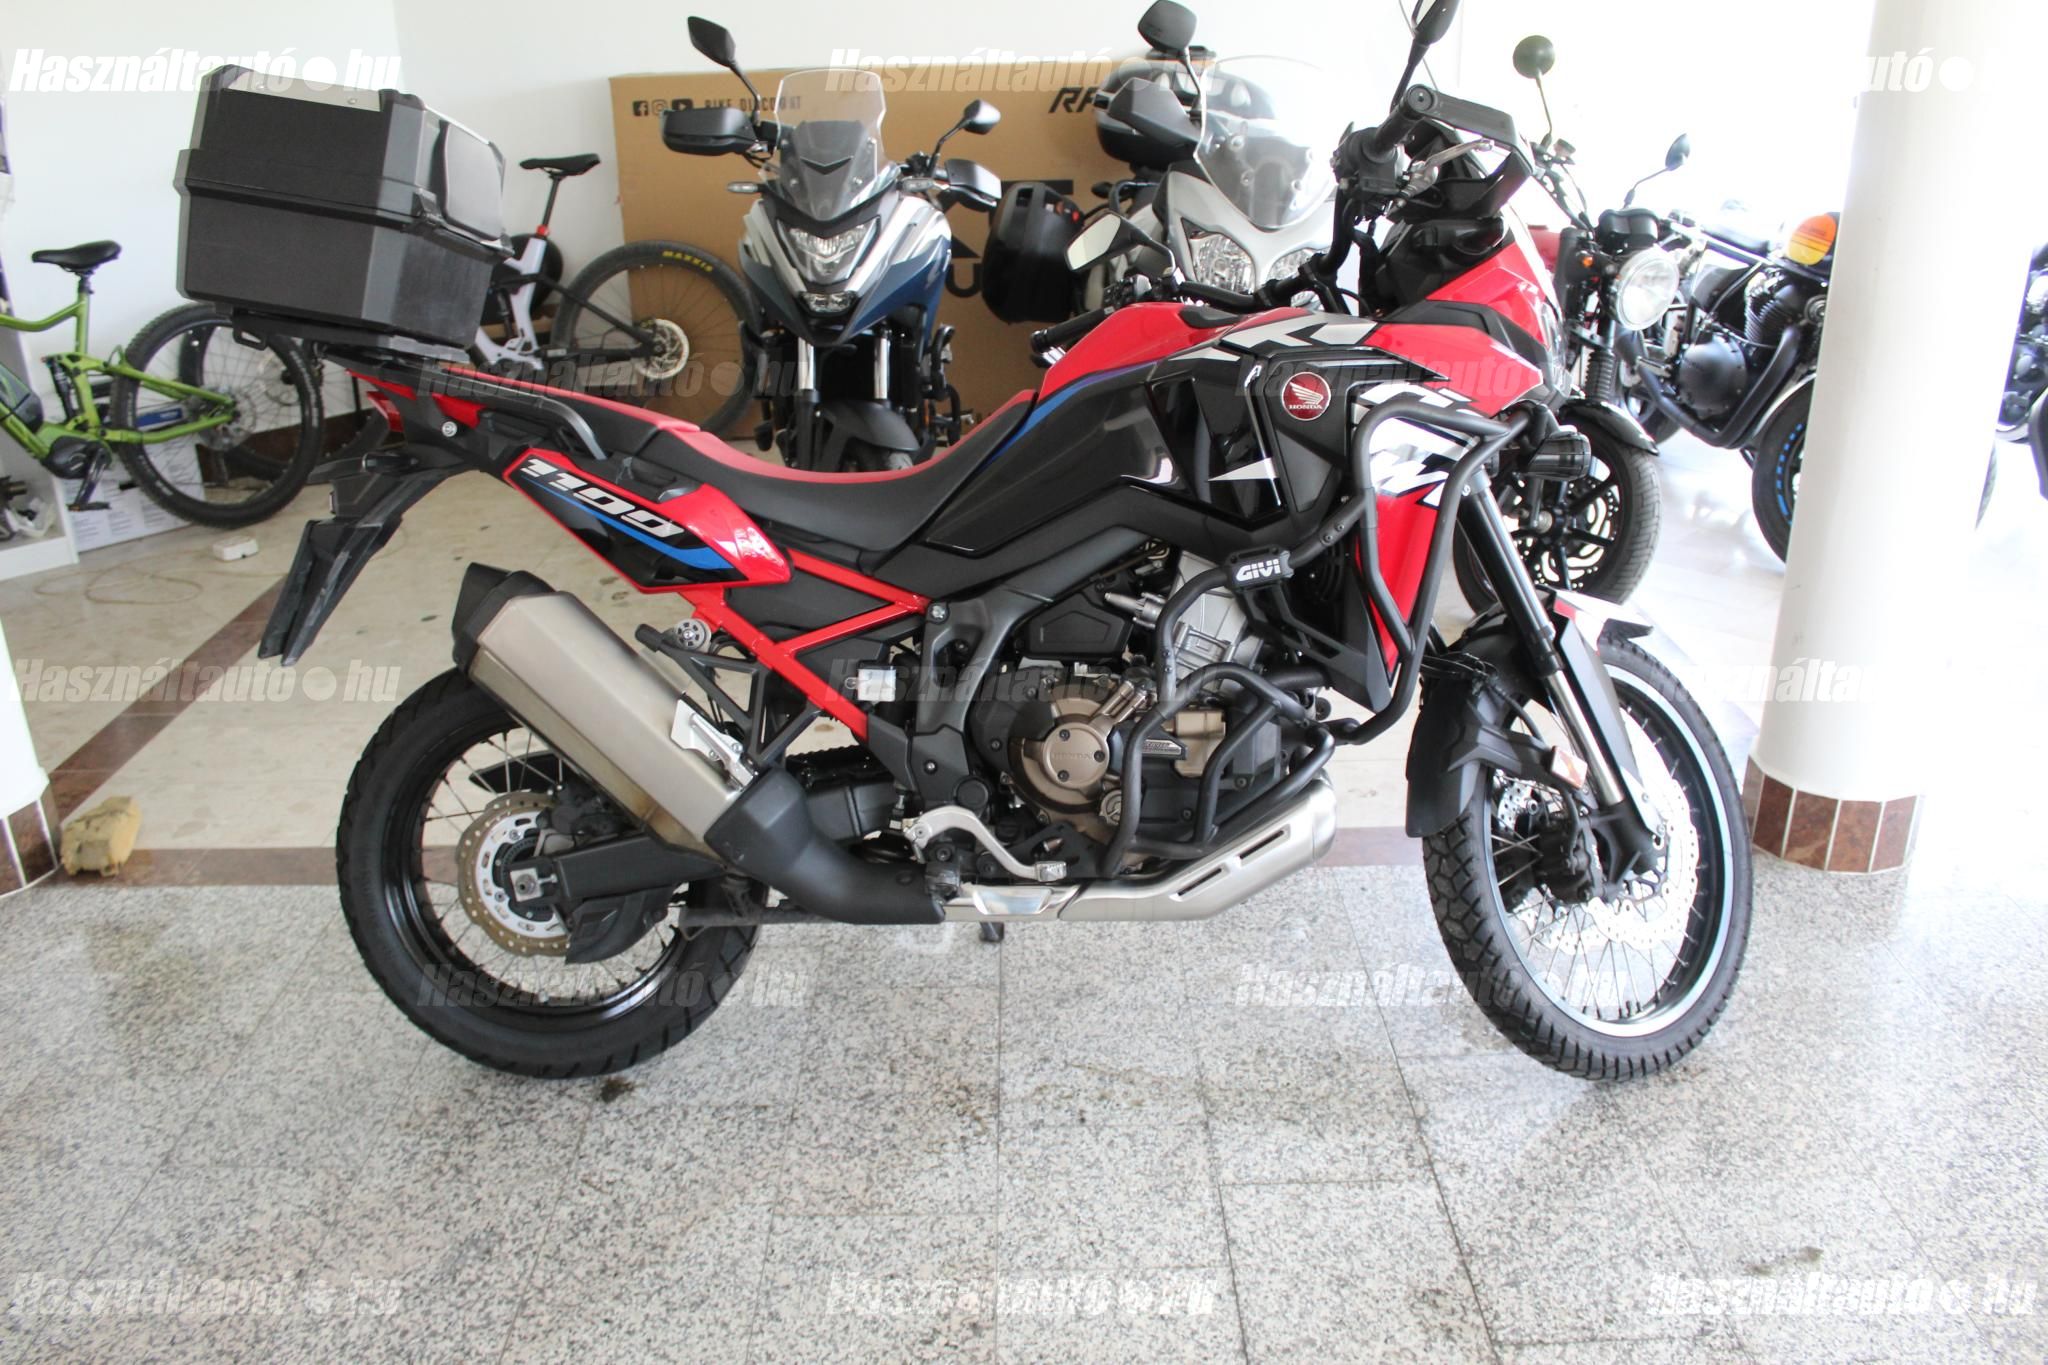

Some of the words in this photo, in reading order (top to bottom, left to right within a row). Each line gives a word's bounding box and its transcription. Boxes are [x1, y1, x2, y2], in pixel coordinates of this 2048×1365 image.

[740, 97, 802, 112] DICOUNT
[520, 458, 685, 538] 1100
[1236, 559, 1281, 581] GIVI
